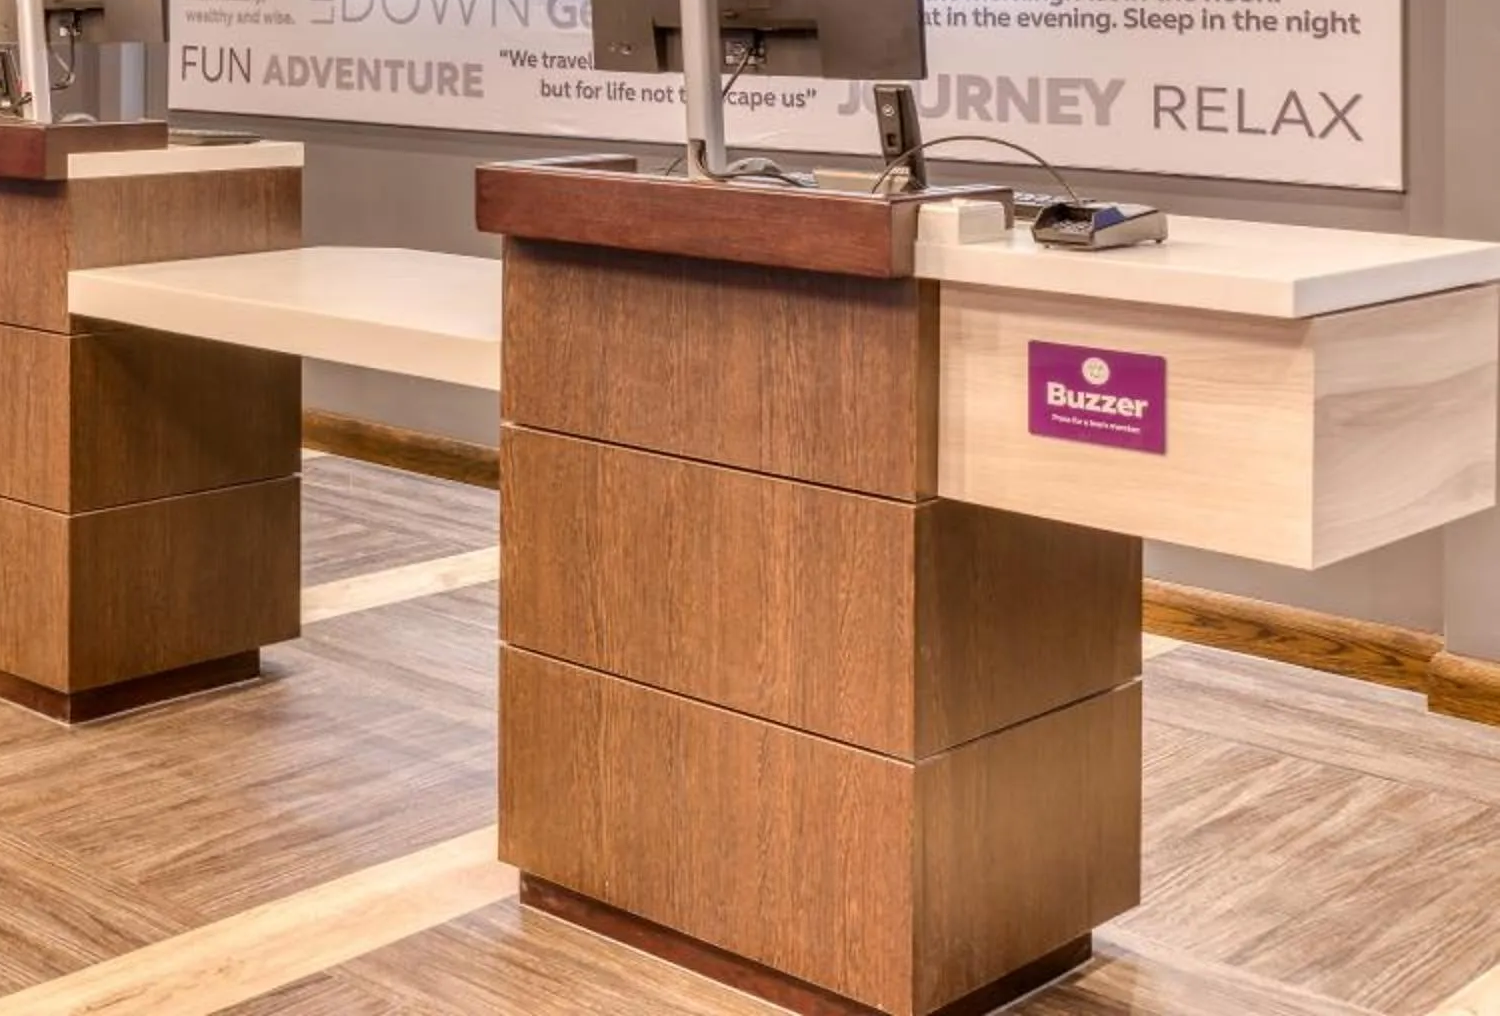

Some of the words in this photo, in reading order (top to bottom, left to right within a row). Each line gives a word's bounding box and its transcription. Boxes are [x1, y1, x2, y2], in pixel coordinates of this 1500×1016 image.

[185, 8, 233, 27] wealthy
[237, 9, 260, 25] and
[924, 7, 941, 27] at
[947, 6, 967, 27] in
[972, 6, 1010, 27] the
[1017, 7, 1117, 34] evening.
[1123, 7, 1195, 34] Sleep
[1201, 7, 1226, 30] in
[1232, 9, 1279, 32] the
[1286, 10, 1362, 39] night
[181, 45, 251, 83] FUN
[262, 54, 485, 99] ADVENTURE
[540, 79, 570, 98] but
[576, 80, 602, 100] for
[607, 80, 636, 101] life
[641, 85, 673, 104] not
[725, 90, 776, 111] cape
[838, 73, 1126, 126] JURNEY
[1153, 84, 1363, 142] RELAX
[1047, 381, 1149, 419] Buzzer
